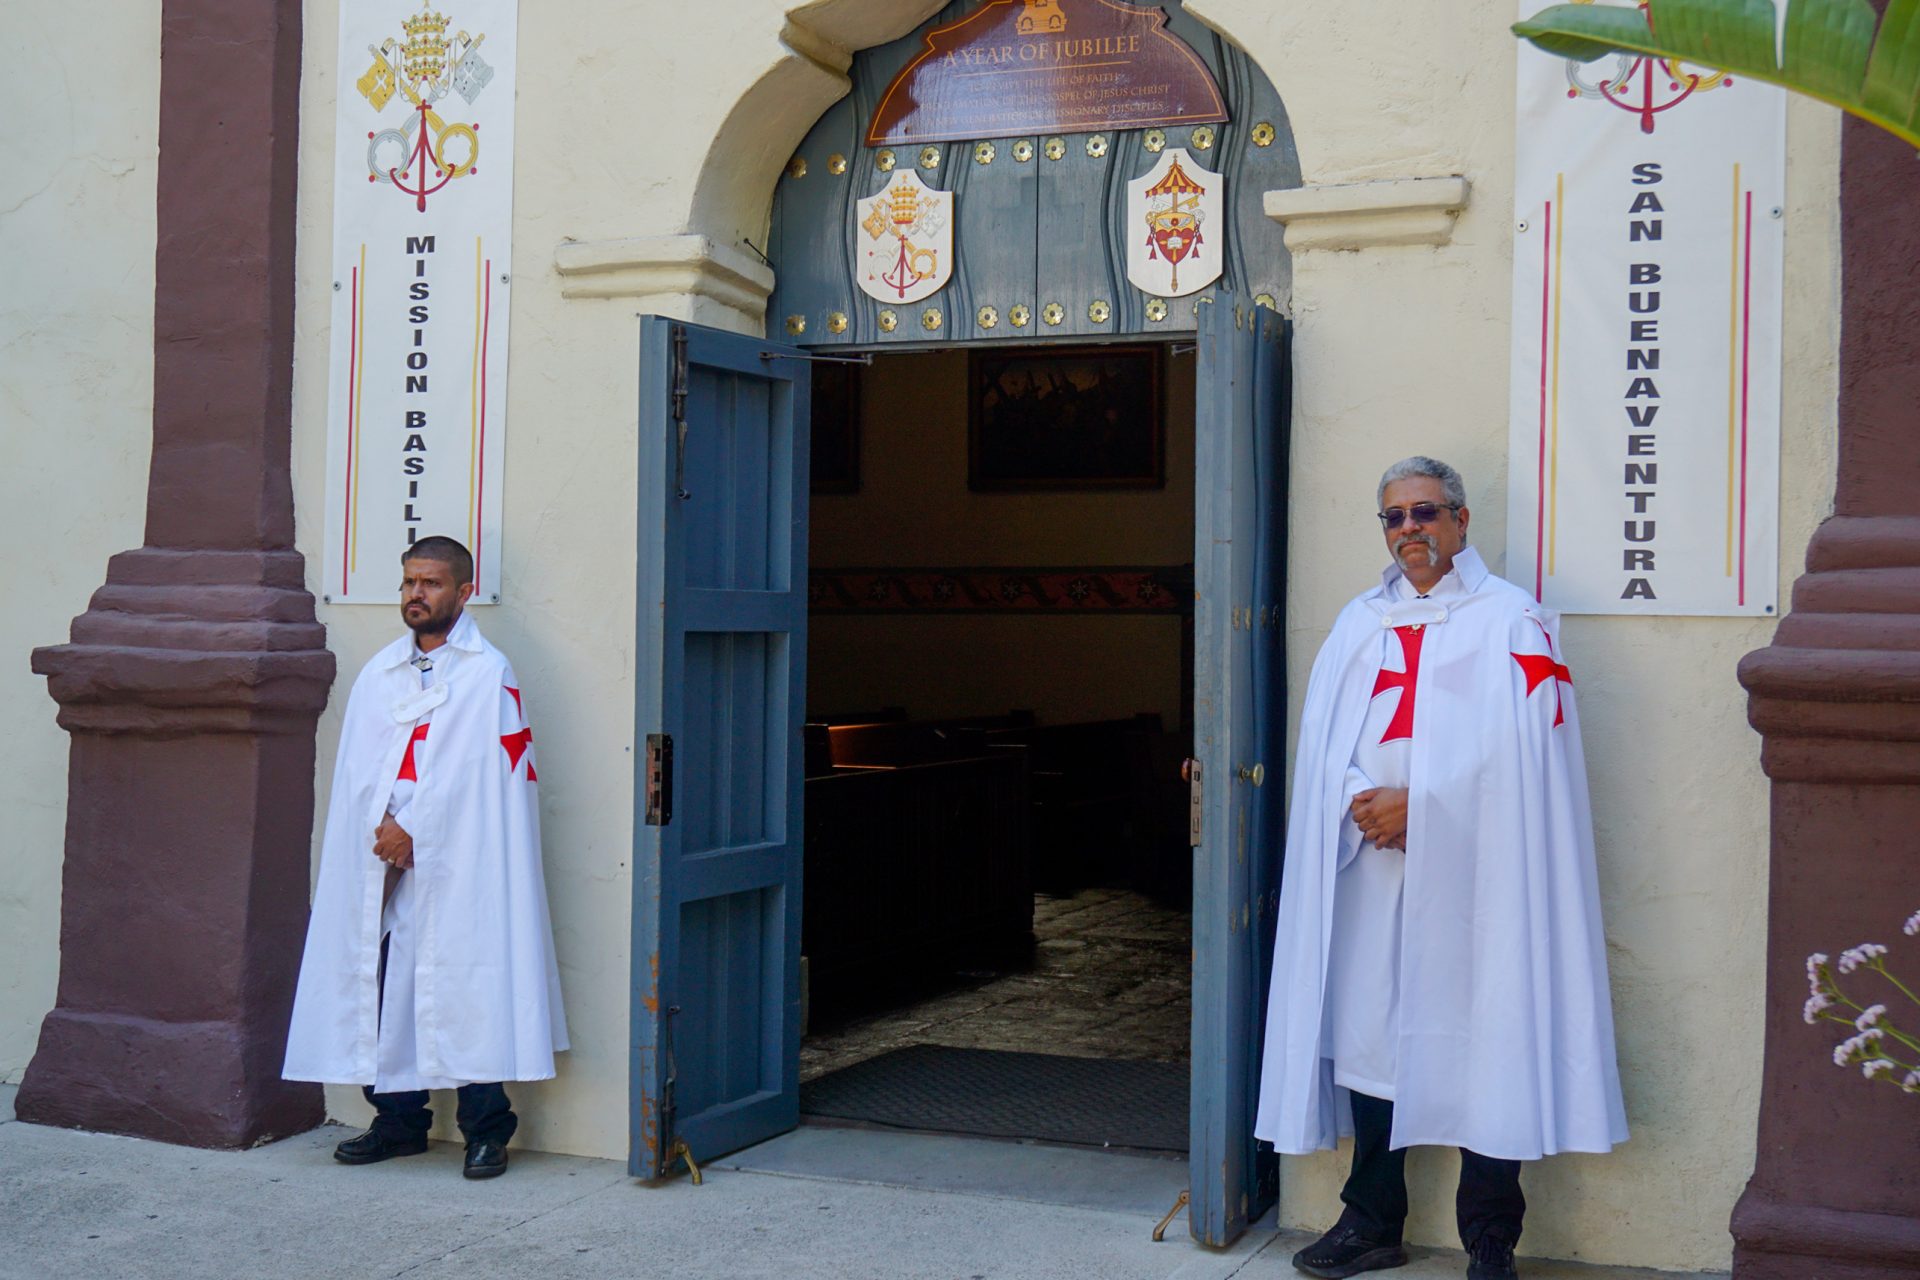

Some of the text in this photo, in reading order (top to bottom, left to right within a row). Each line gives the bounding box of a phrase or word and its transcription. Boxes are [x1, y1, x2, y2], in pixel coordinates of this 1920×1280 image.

[943, 34, 1140, 68] A YEAR OF JUBILEE
[1025, 77, 1045, 88] THE
[1069, 74, 1085, 85] OF
[1042, 91, 1080, 103] GOSPEL
[1083, 89, 1097, 100] OF
[1098, 87, 1128, 102] JESUS
[1131, 83, 1171, 96] CHRIST
[1620, 162, 1664, 600] SAN BUENAVENTURA
[400, 235, 436, 591] MISSION BASILI
